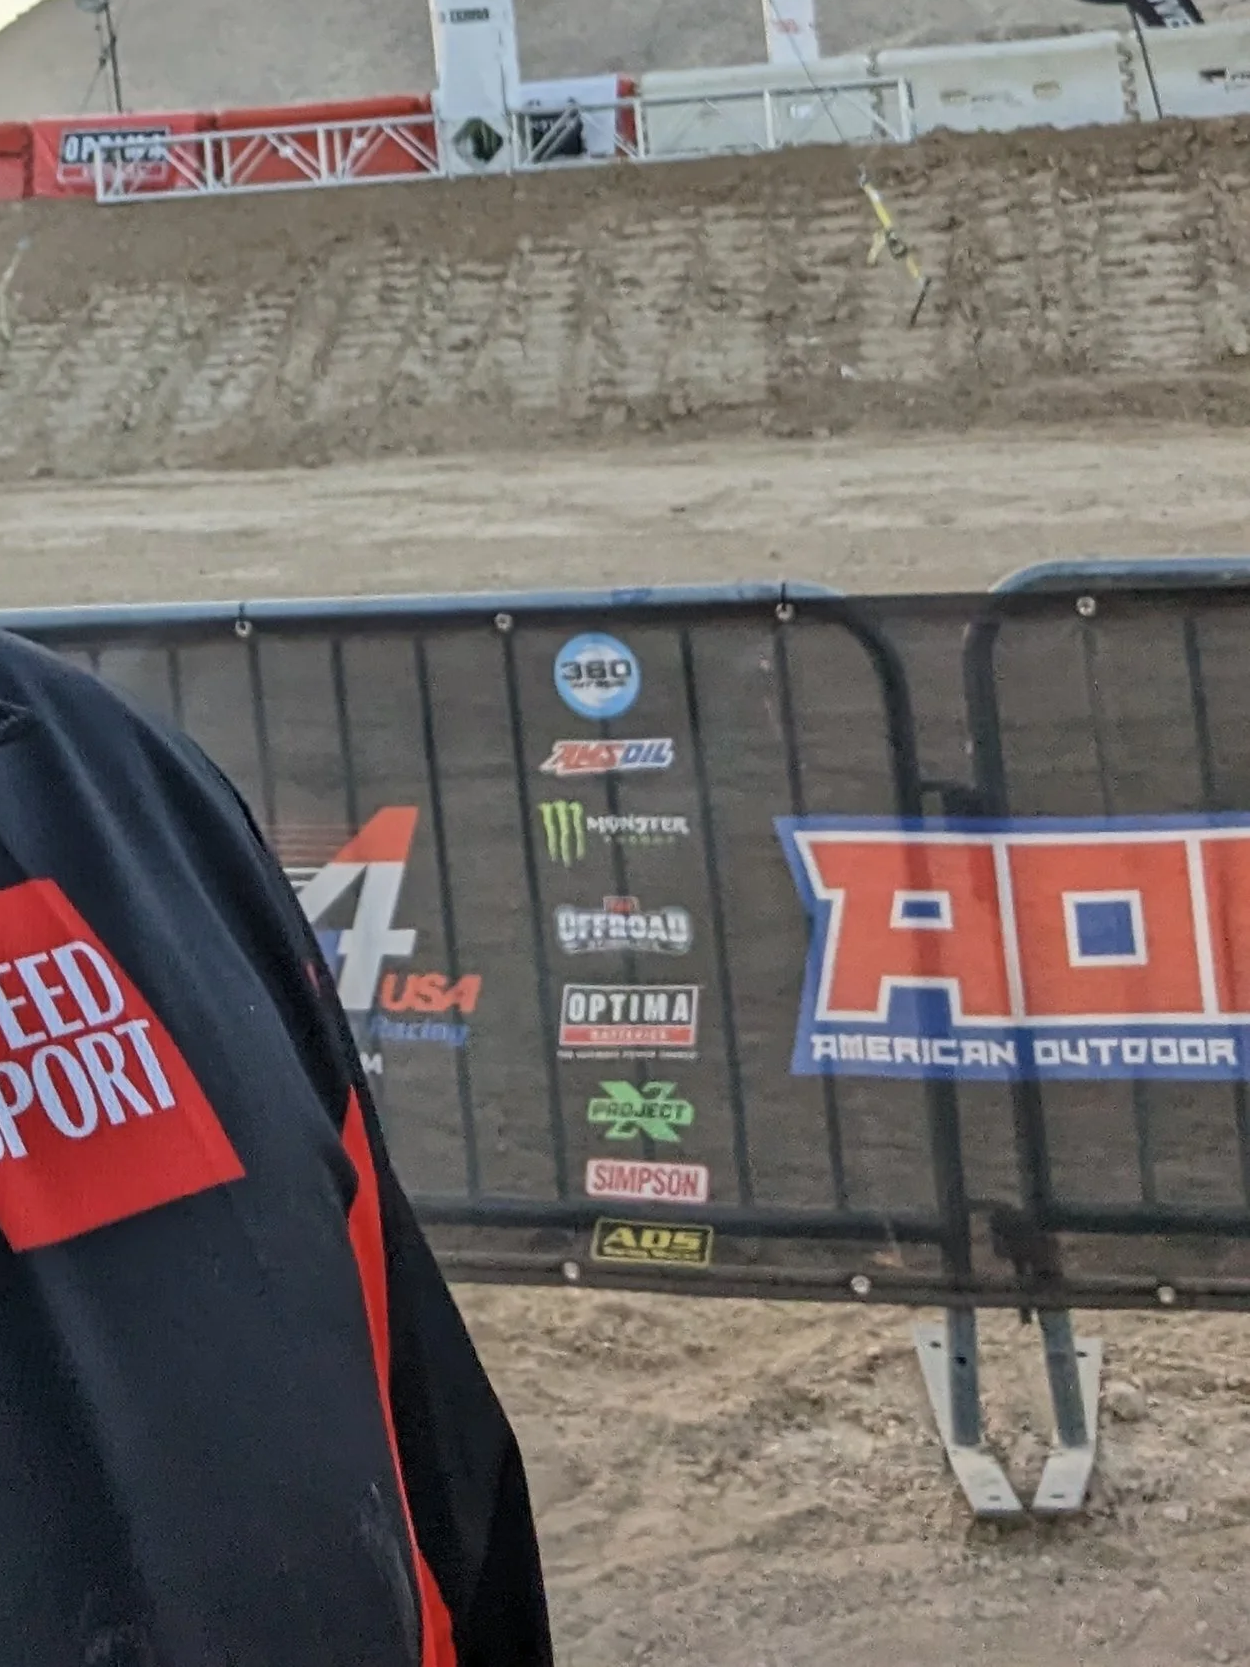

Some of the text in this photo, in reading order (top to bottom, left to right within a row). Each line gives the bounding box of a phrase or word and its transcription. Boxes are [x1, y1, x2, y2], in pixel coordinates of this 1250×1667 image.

[586, 815, 690, 835] MONSTER
[380, 971, 482, 1014] USA
[568, 992, 690, 1022] OPTIMA
[811, 1033, 1239, 1067] AMERICAN OUTDOOR
[592, 1101, 687, 1120] PROJECT
[593, 1163, 699, 1197] SIMPSON
